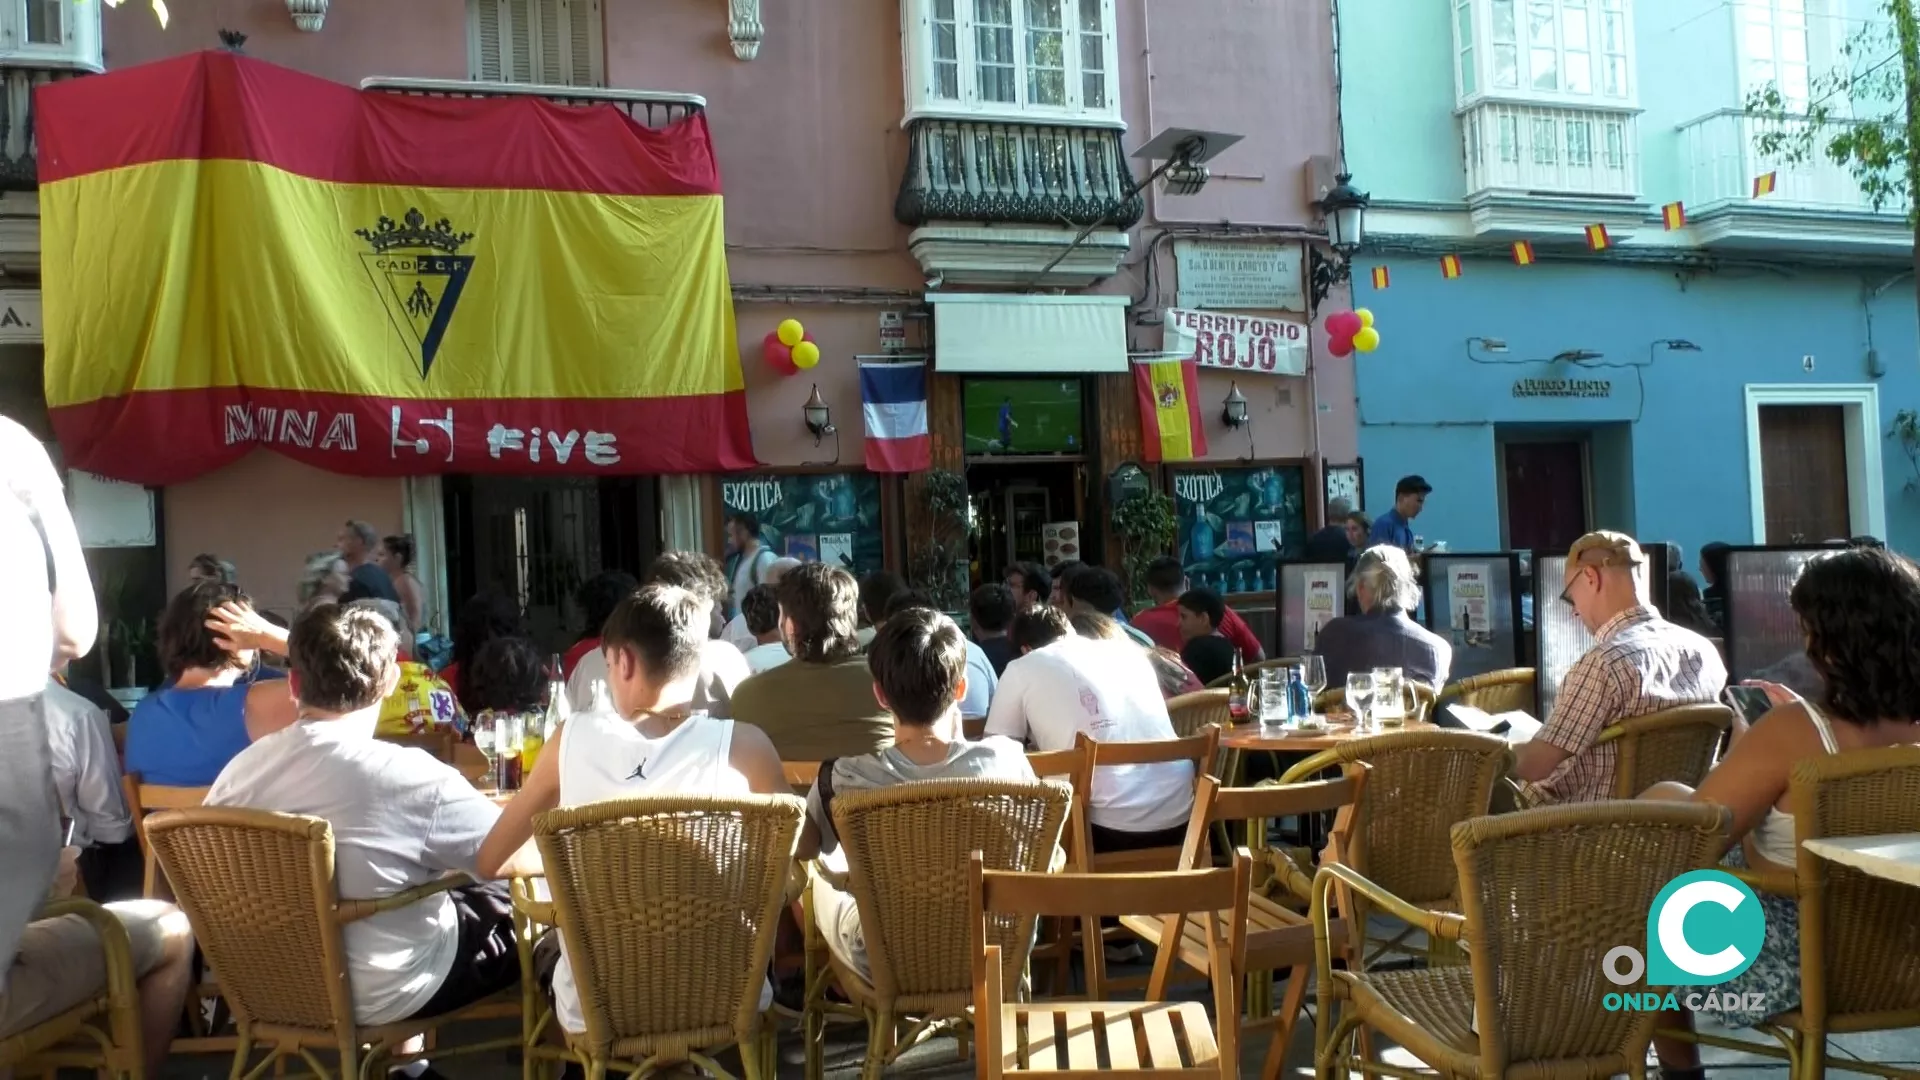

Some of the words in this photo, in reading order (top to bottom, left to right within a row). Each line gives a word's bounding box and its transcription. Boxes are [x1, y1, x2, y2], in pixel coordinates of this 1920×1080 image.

[376, 260, 429, 270] CADIZ
[1173, 311, 1300, 341] TERRITORIO
[1194, 331, 1277, 370] ROJO
[1804, 356, 1812, 371] 4
